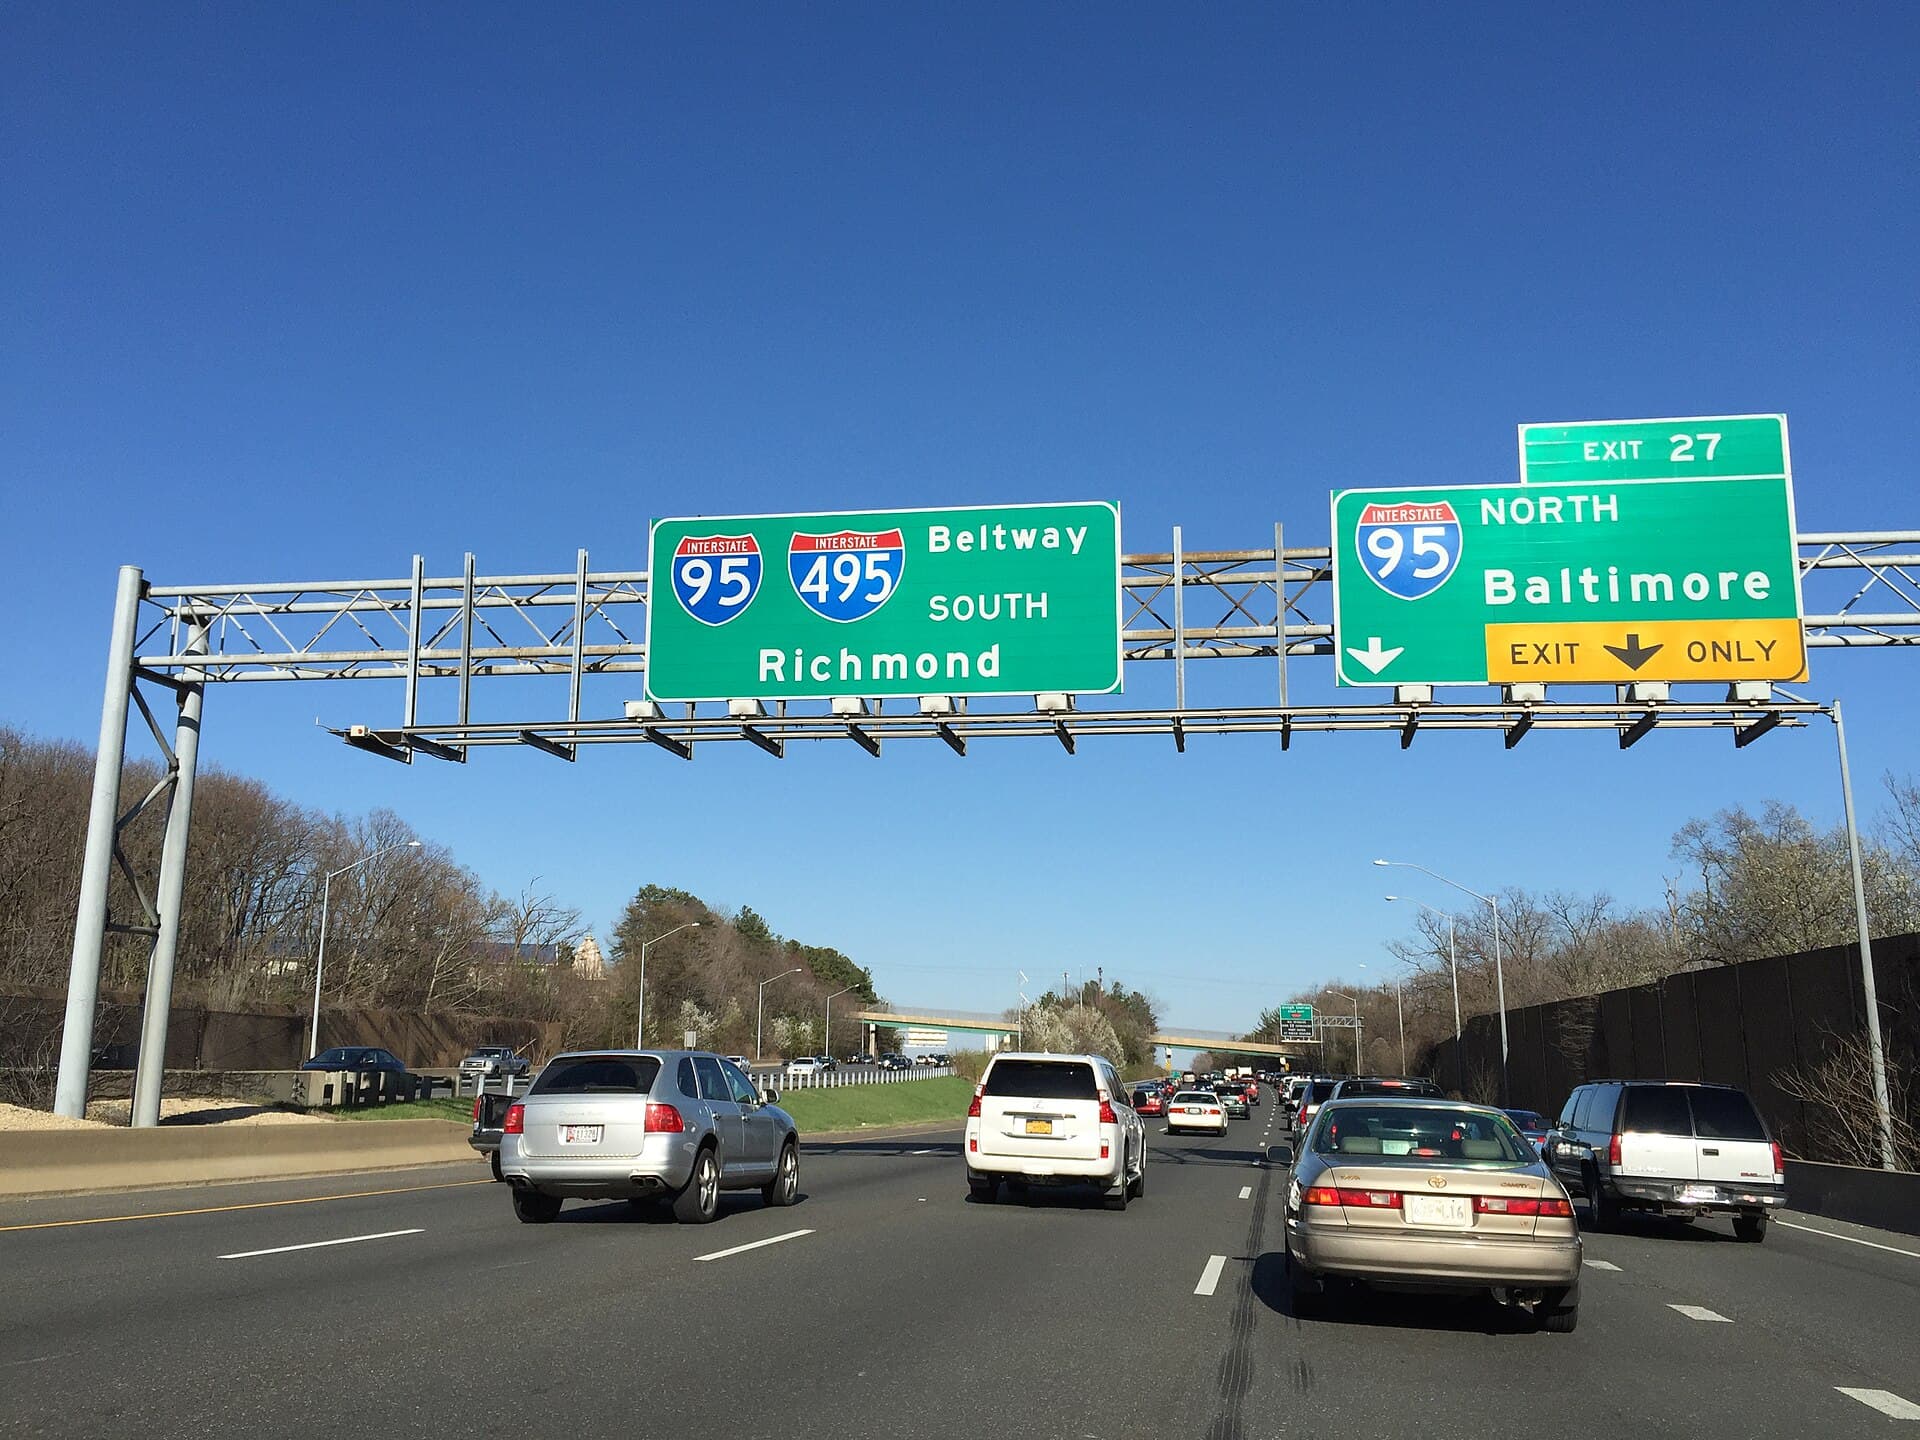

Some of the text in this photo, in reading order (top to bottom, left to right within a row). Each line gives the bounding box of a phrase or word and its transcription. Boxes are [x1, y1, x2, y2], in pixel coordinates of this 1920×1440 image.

[1583, 432, 1723, 463] EXIT 27
[1371, 507, 1444, 523] INTERSTATE
[1480, 493, 1619, 526] NORTH
[686, 537, 749, 554] INTERSTATE
[814, 535, 878, 550] INTERSTATE
[928, 524, 1088, 554] Beltway
[1366, 526, 1450, 580] 95
[679, 557, 751, 607] 95
[799, 552, 893, 604] 495
[1483, 565, 1772, 605] Baltimore
[928, 591, 1049, 622] SOUTH
[758, 643, 1001, 682] Richmond
[1510, 639, 1777, 666] EXIT ONLY
